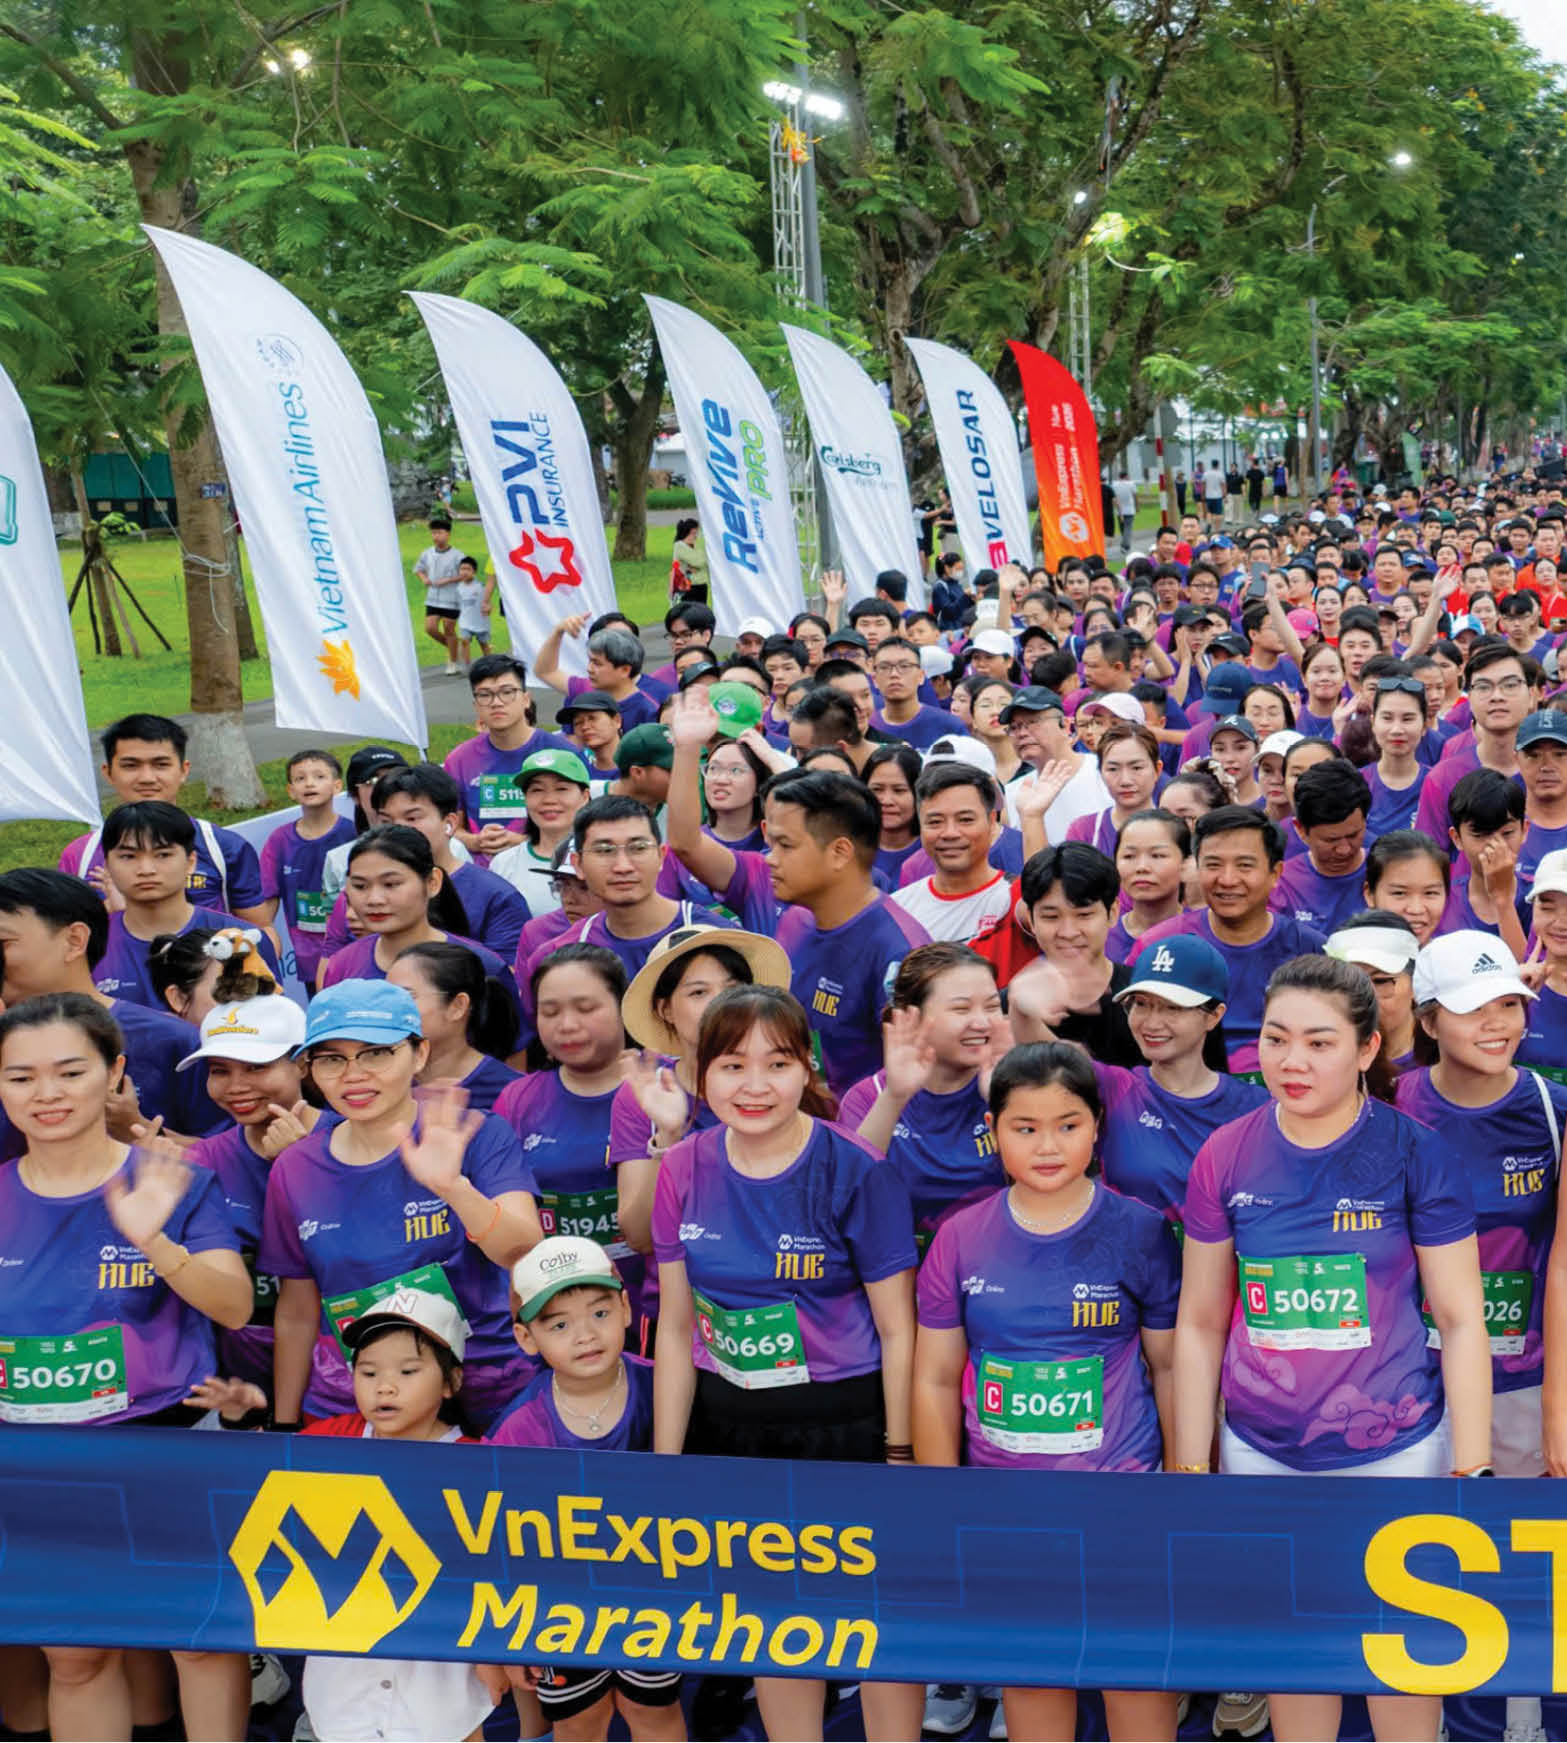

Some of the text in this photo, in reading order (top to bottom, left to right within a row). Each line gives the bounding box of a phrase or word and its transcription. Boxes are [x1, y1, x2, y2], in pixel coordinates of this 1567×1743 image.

[490, 418, 551, 526] PVI
[530, 410, 568, 528] INSURANCE
[740, 419, 773, 502] PRO
[956, 389, 1003, 540] VELOSAR
[281, 381, 349, 635] Vietnam Airlines
[775, 1251, 825, 1281] HUE
[1249, 1286, 1359, 1313] C 50672
[712, 1332, 794, 1358] 50669
[1071, 1300, 1120, 1328] HUE
[12, 1357, 117, 1390] 50670
[1010, 1389, 1093, 1417] 50671
[442, 1489, 876, 1578] VnExpress
[456, 1582, 879, 1670] Marathon
